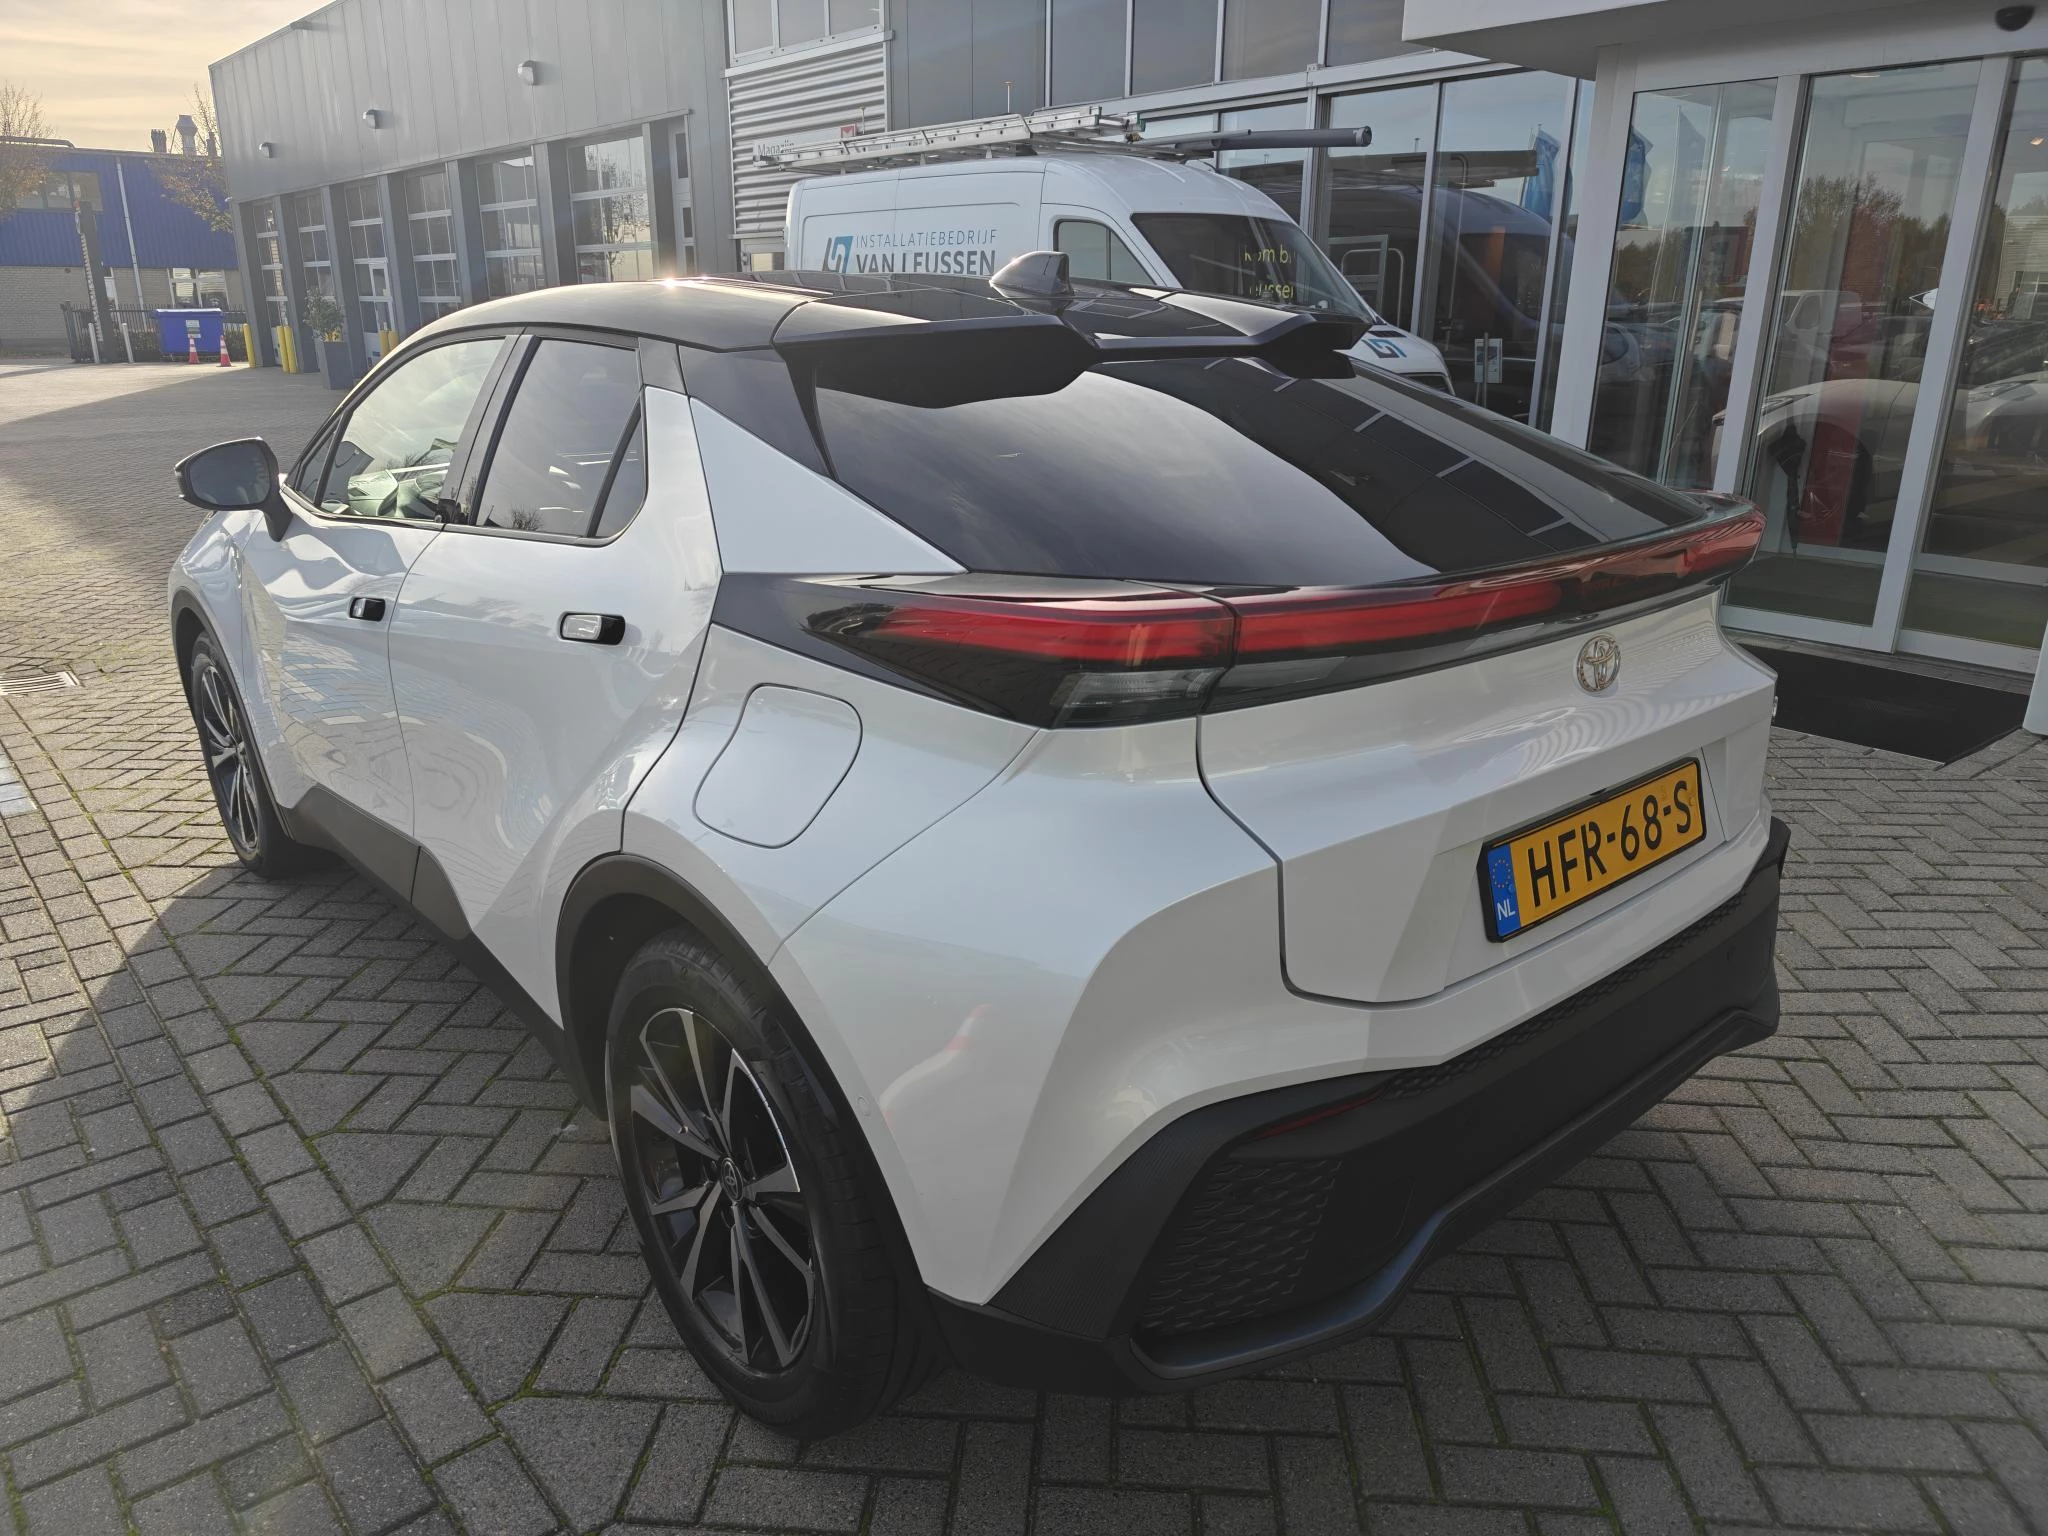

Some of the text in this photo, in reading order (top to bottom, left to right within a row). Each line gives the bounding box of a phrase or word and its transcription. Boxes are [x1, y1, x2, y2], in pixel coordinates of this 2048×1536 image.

[856, 229, 998, 249] INSTALLATIEBEDRIJF
[856, 252, 895, 273] VAN
[1527, 780, 1692, 908] HFR-68-S
[1496, 898, 1516, 921] NL
